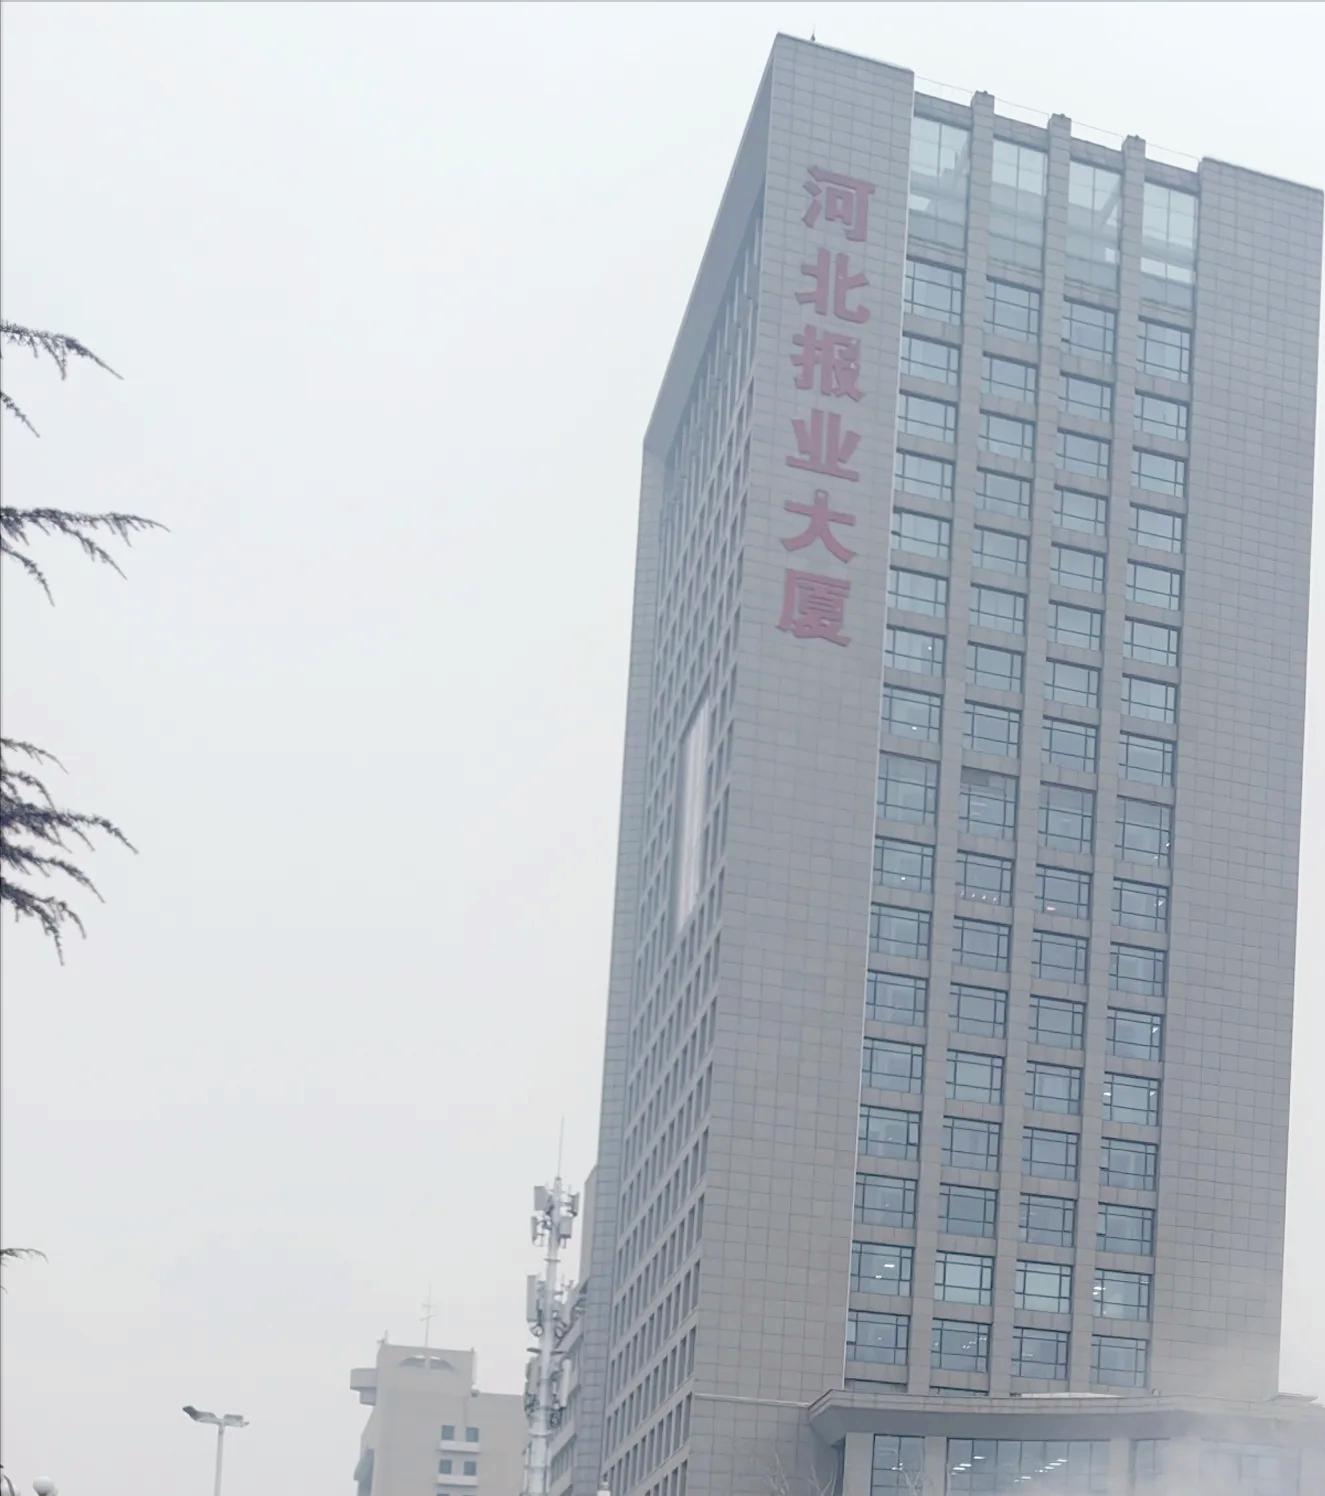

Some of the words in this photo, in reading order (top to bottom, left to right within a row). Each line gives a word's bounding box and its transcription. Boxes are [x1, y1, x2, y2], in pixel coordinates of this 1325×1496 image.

[775, 165, 876, 648] 河北报业大厦
